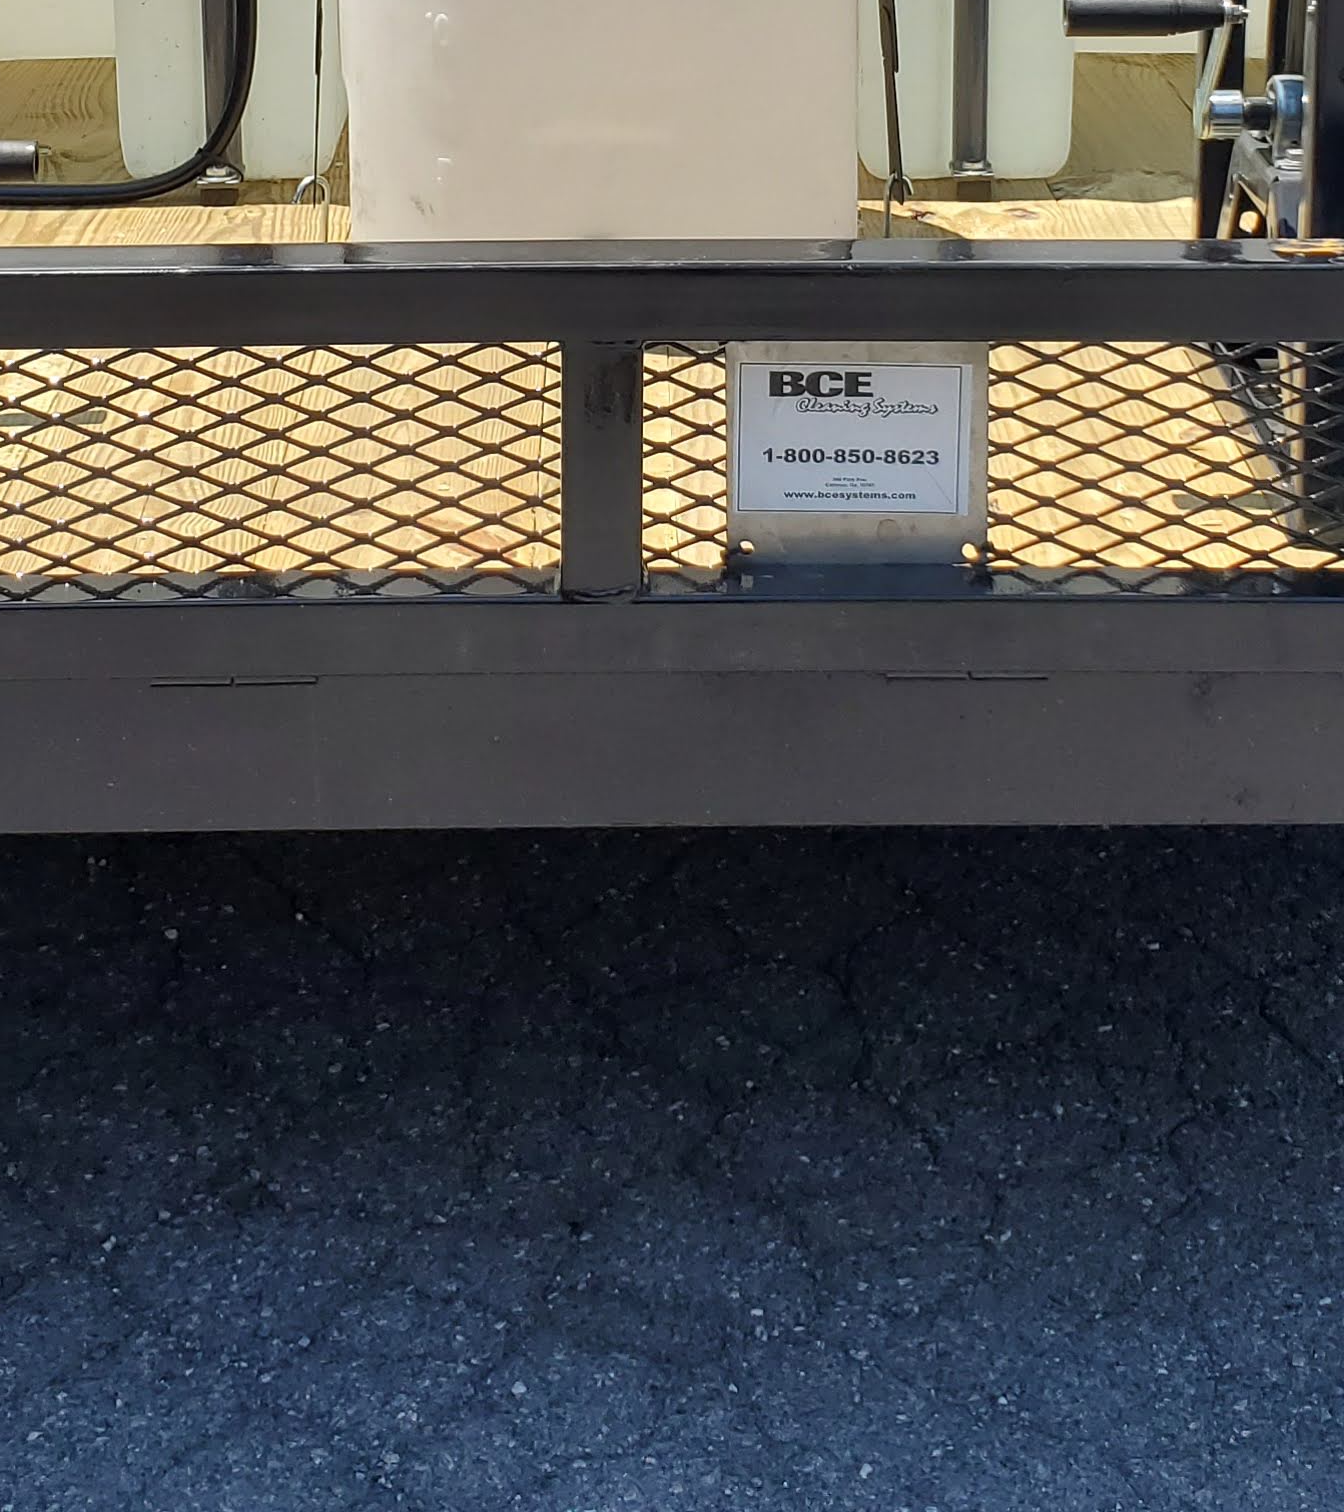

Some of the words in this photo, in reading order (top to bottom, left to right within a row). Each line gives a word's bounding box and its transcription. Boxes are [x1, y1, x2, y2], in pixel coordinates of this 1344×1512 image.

[768, 371, 874, 398] BCE
[796, 397, 871, 417] Cleaning
[872, 397, 939, 418] Systems
[762, 447, 940, 465] 1-800-850-8623
[783, 490, 917, 501] www.bcesystems.com
